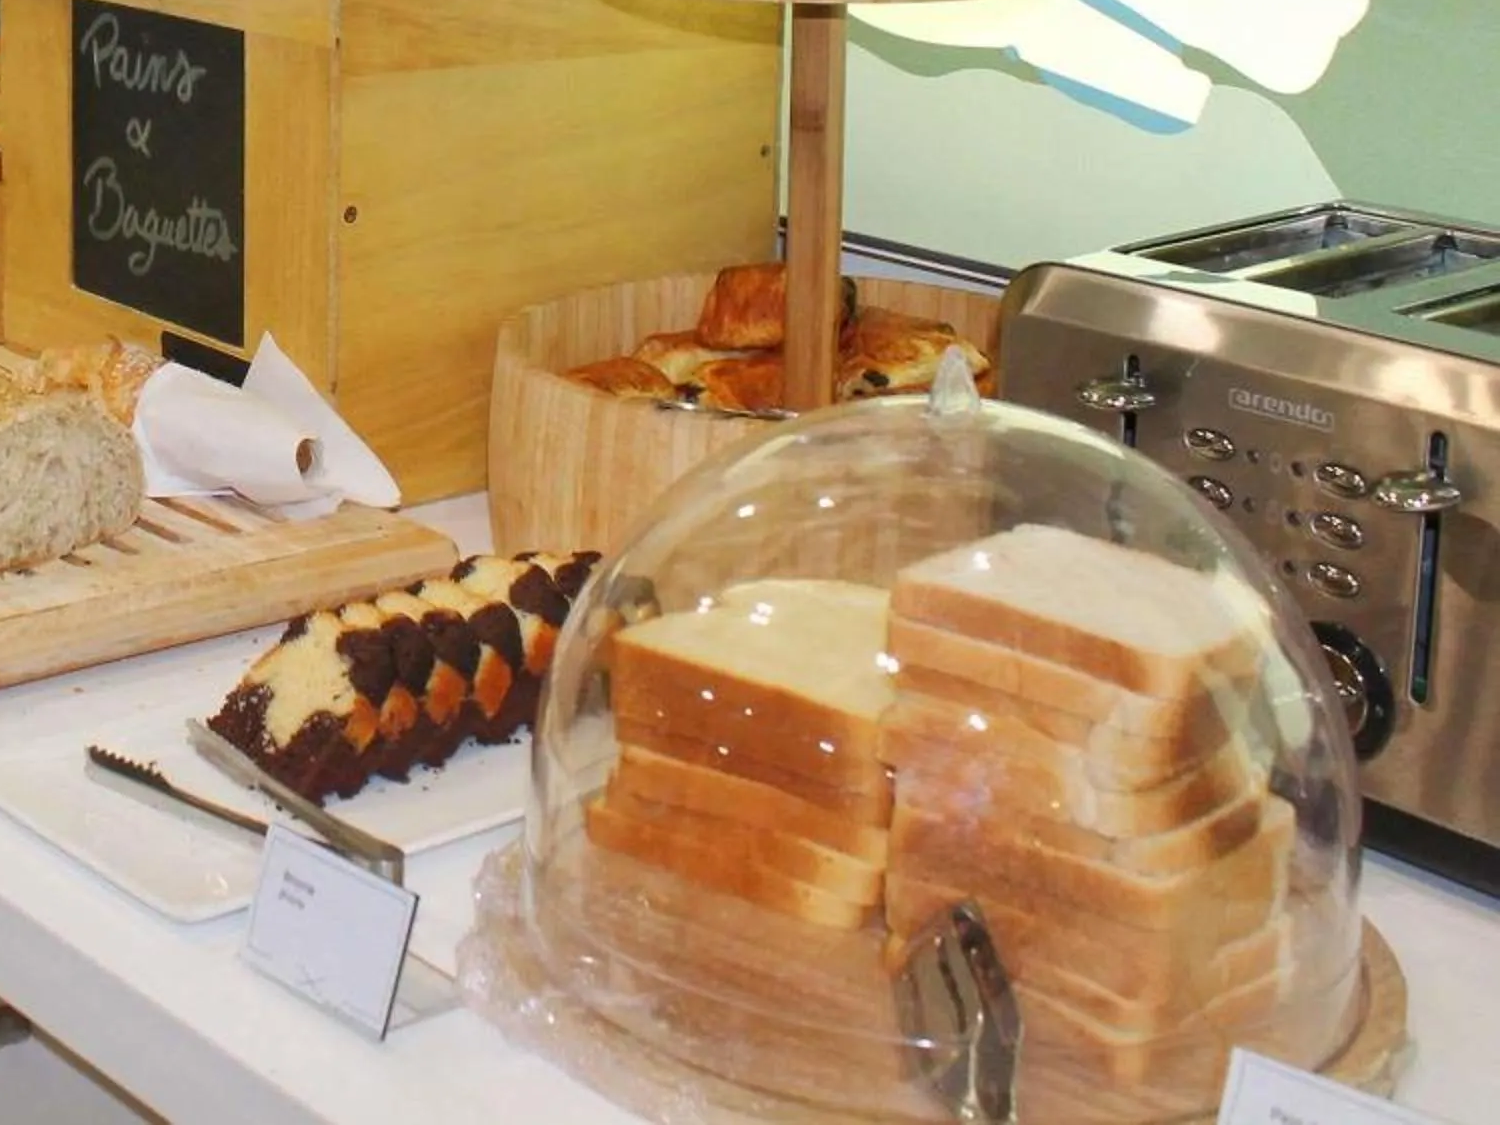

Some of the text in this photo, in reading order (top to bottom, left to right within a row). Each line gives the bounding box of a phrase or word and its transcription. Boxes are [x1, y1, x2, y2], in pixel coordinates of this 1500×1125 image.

[80, 12, 207, 104] Pains
[83, 156, 238, 275] Baguettes
[1232, 390, 1330, 428] arendo
